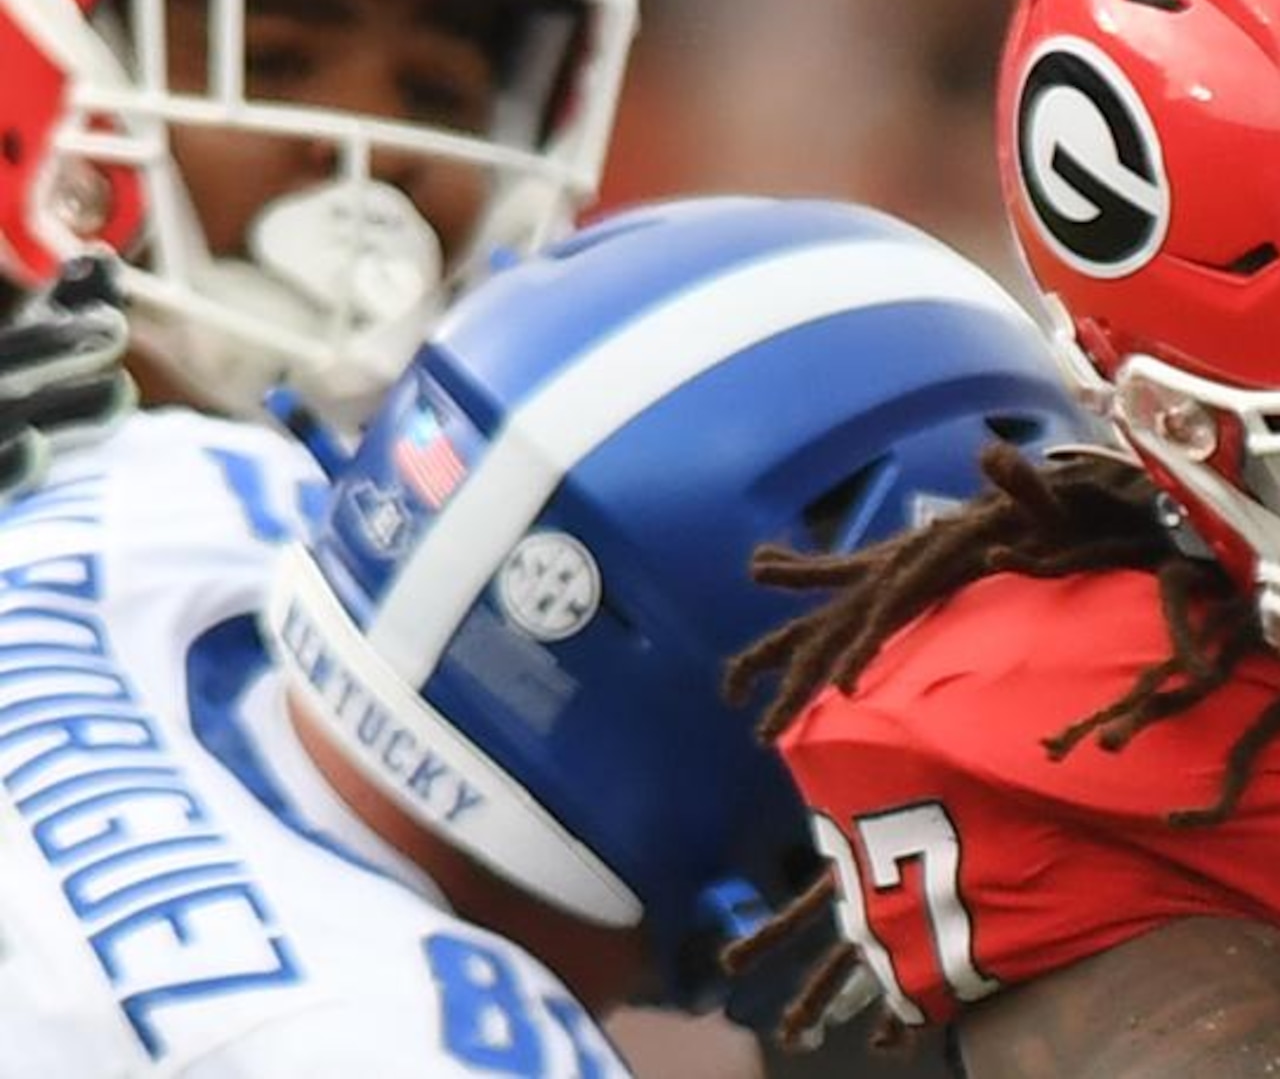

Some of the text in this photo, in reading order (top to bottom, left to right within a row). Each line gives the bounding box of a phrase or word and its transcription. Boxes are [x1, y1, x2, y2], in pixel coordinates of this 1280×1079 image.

[1016, 48, 1163, 278] G
[0, 552, 302, 1063] RODRIGUEZ
[281, 595, 487, 822] KENTUCKY
